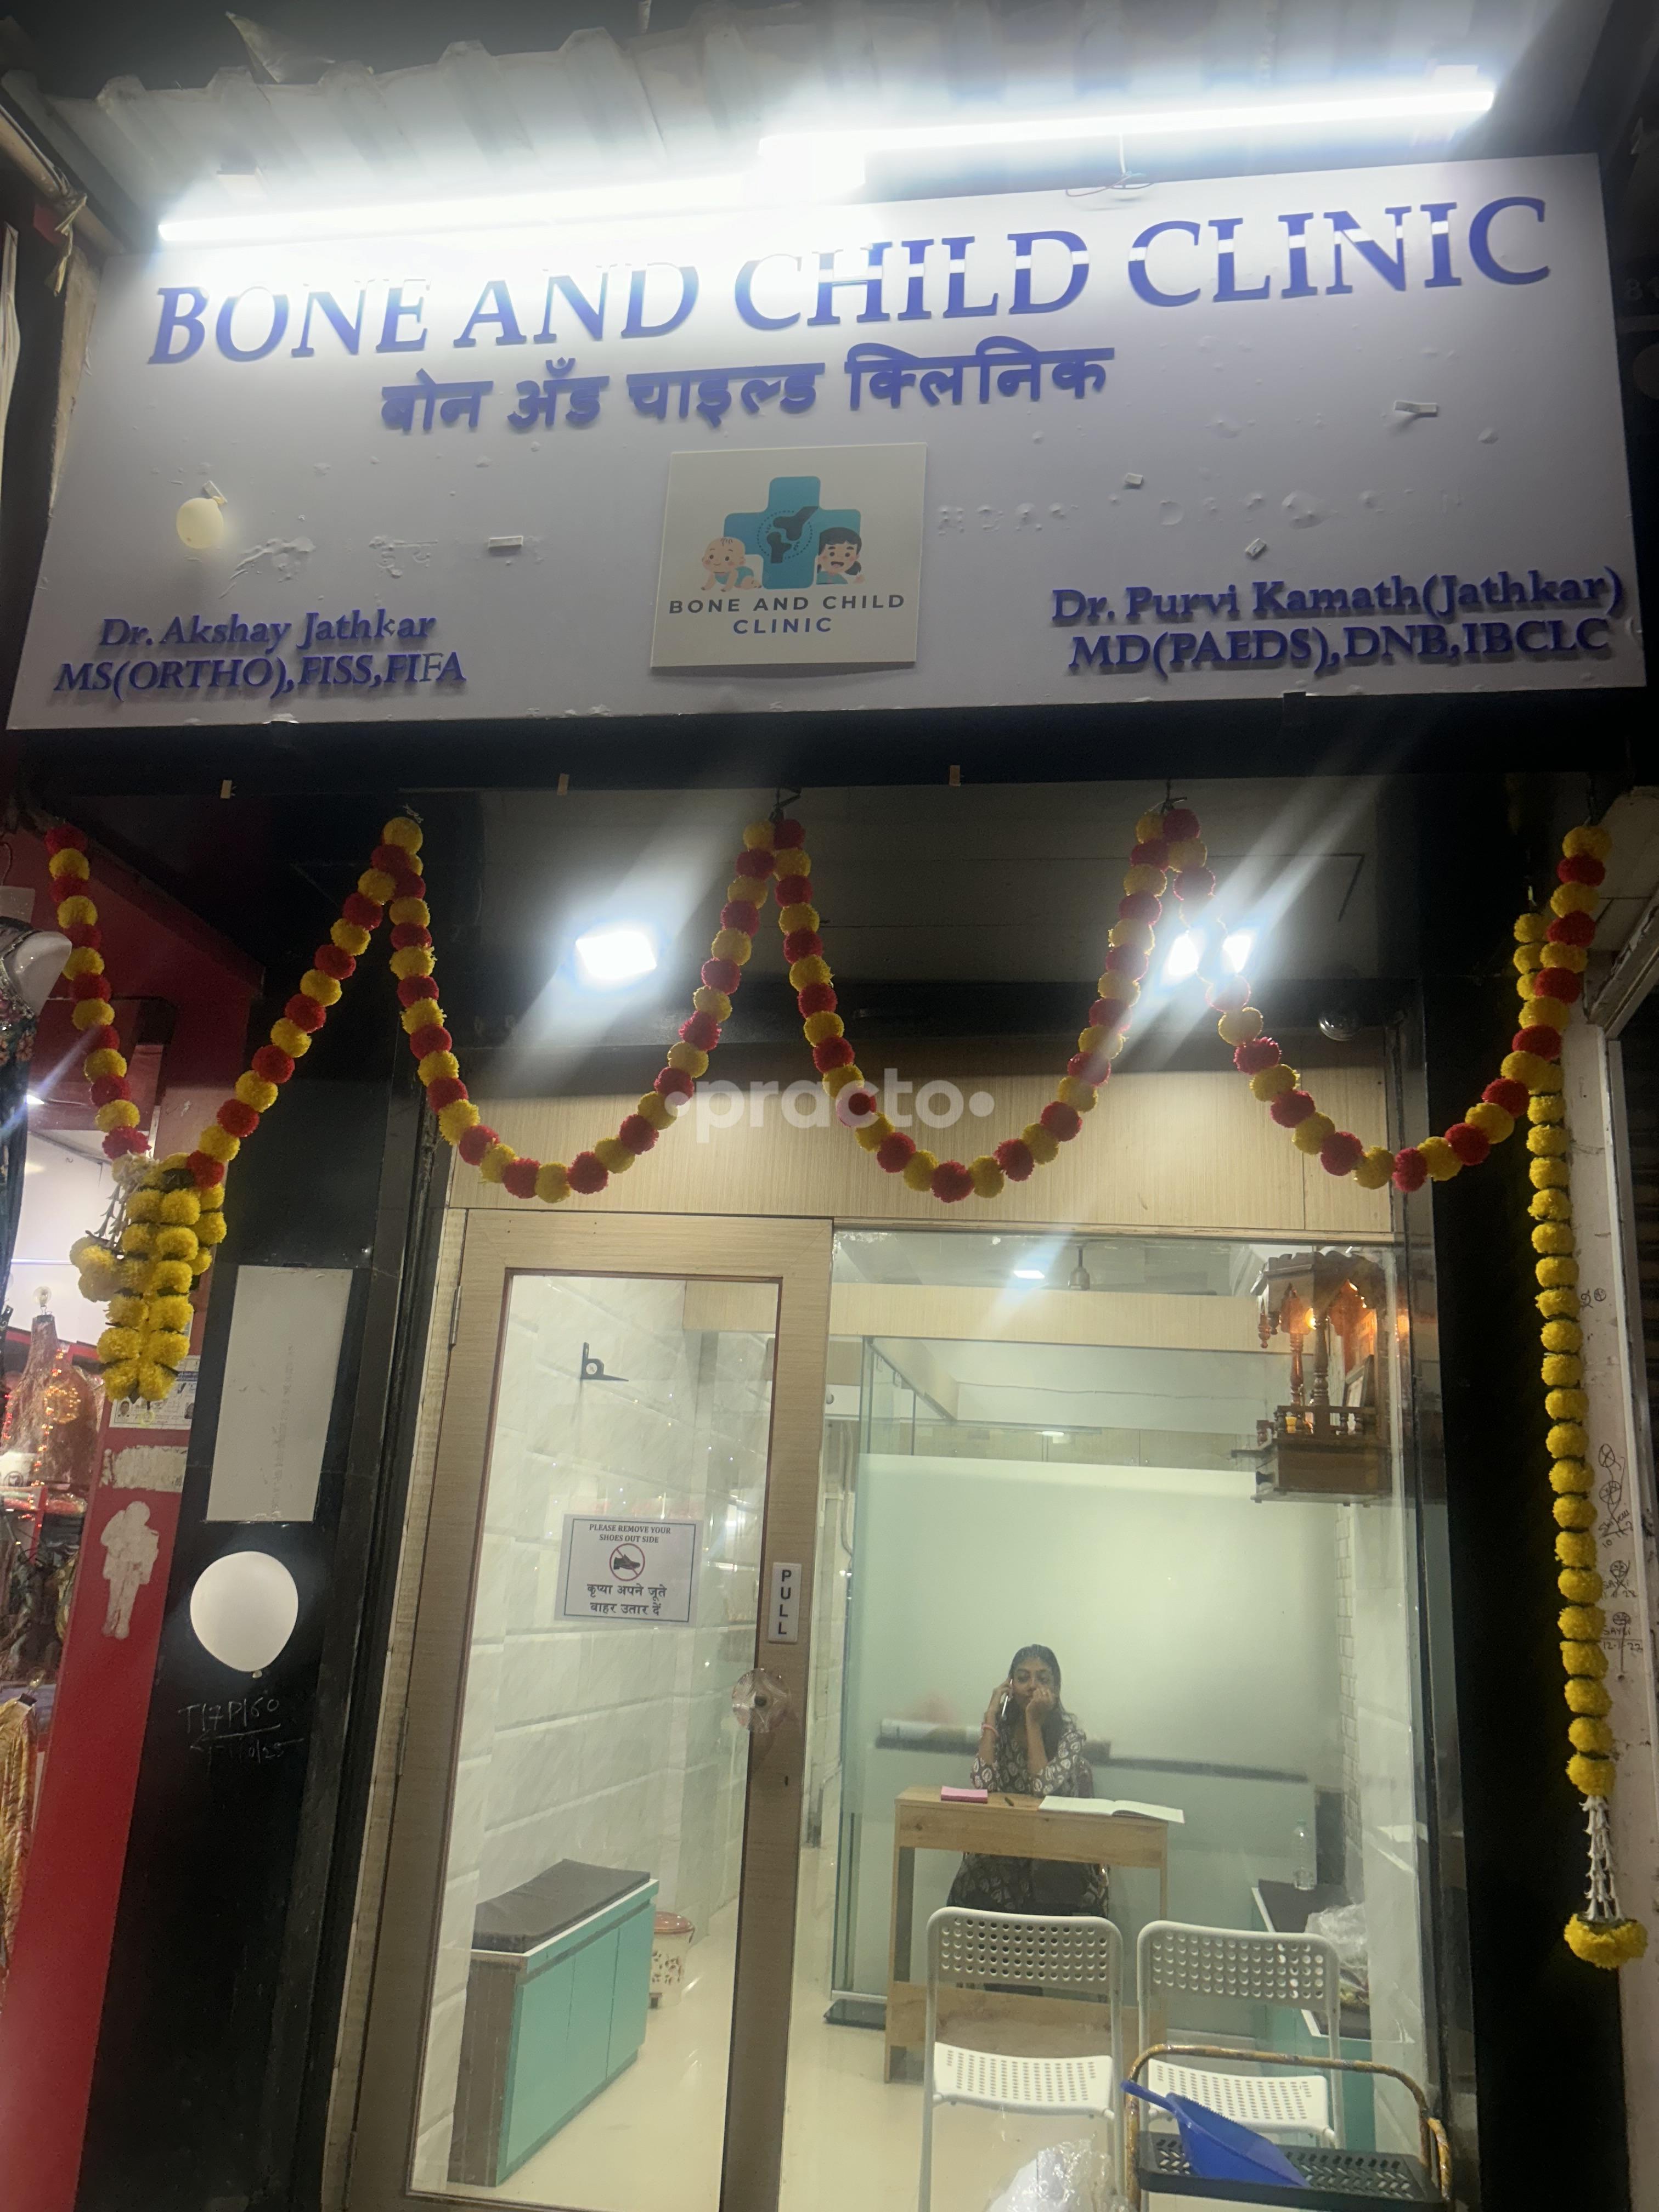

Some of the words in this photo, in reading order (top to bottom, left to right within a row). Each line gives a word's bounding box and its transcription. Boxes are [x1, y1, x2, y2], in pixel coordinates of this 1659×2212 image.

[148, 278, 430, 364] BONE
[454, 262, 699, 348] AND
[735, 230, 1089, 330] CHILD
[1128, 196, 1550, 307] CLINIC
[381, 368, 493, 434] बोन
[626, 363, 825, 428] चाइल्ड
[844, 336, 1114, 410] क्लिनिक
[669, 598, 740, 614] BONE
[753, 596, 809, 611] AND
[823, 594, 905, 610] CHILD
[1052, 589, 1114, 623] Dr.
[1126, 584, 1239, 621] Purvi
[1252, 566, 1622, 622] Kamath(Jathkar)
[99, 617, 153, 646] Dr.
[159, 614, 291, 654] Akshay
[296, 608, 436, 650] Jathkar
[733, 617, 832, 634] CLINIC
[1068, 618, 1609, 680] MD(PAEDS),DNB,IBCLC
[590, 1602, 617, 1614] बाहर
[620, 1604, 649, 1615] उतार
[617, 1583, 644, 1596] अपने
[648, 1584, 667, 1601] जूते
[777, 1569, 792, 1635] PULL
